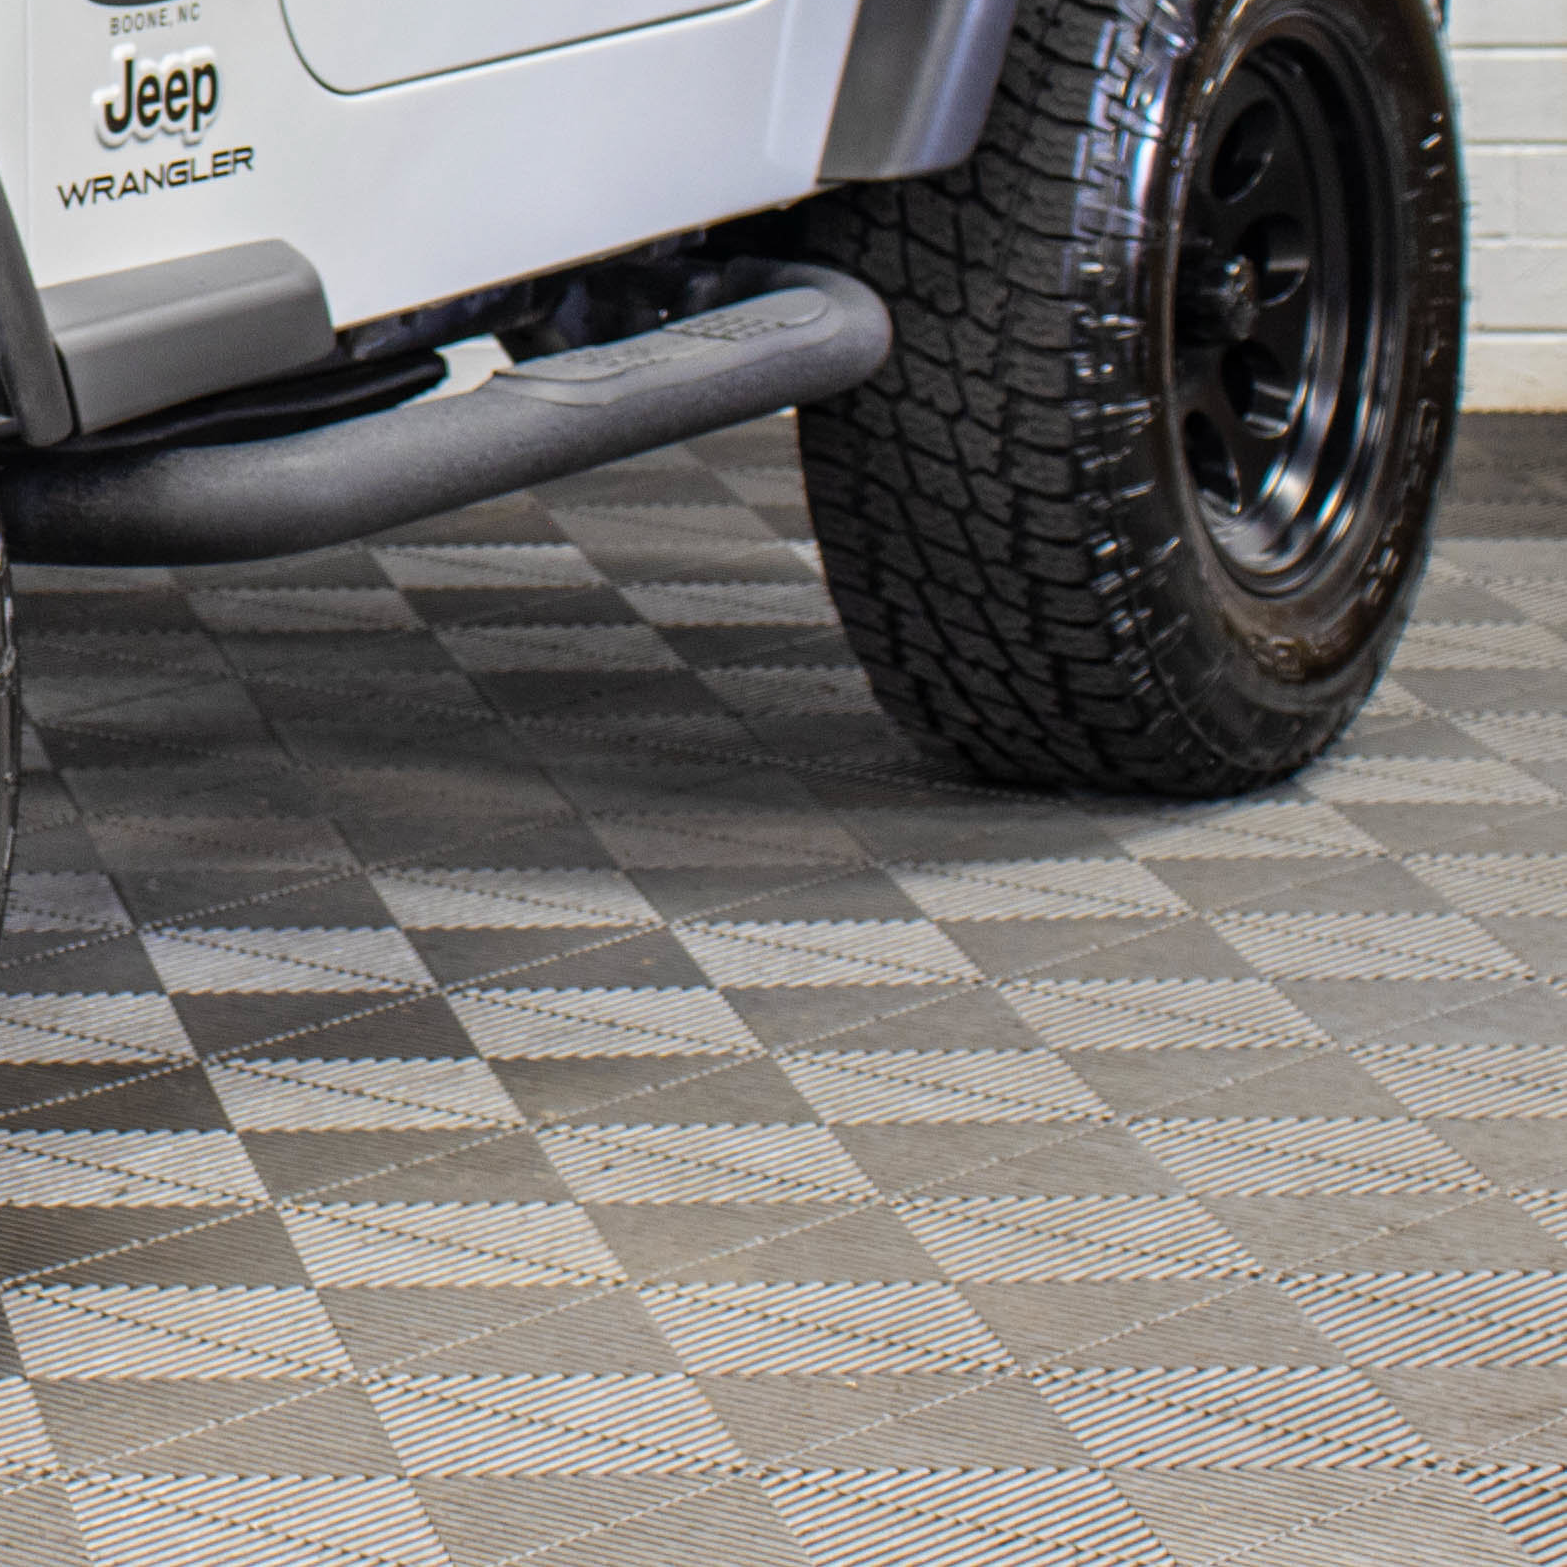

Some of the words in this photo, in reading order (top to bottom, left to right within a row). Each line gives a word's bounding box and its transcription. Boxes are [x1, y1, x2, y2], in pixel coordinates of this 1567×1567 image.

[109, 6, 174, 36] BOONE,
[177, 2, 201, 24] NC
[101, 55, 219, 136] Jeep
[56, 145, 255, 210] WRANGLER
